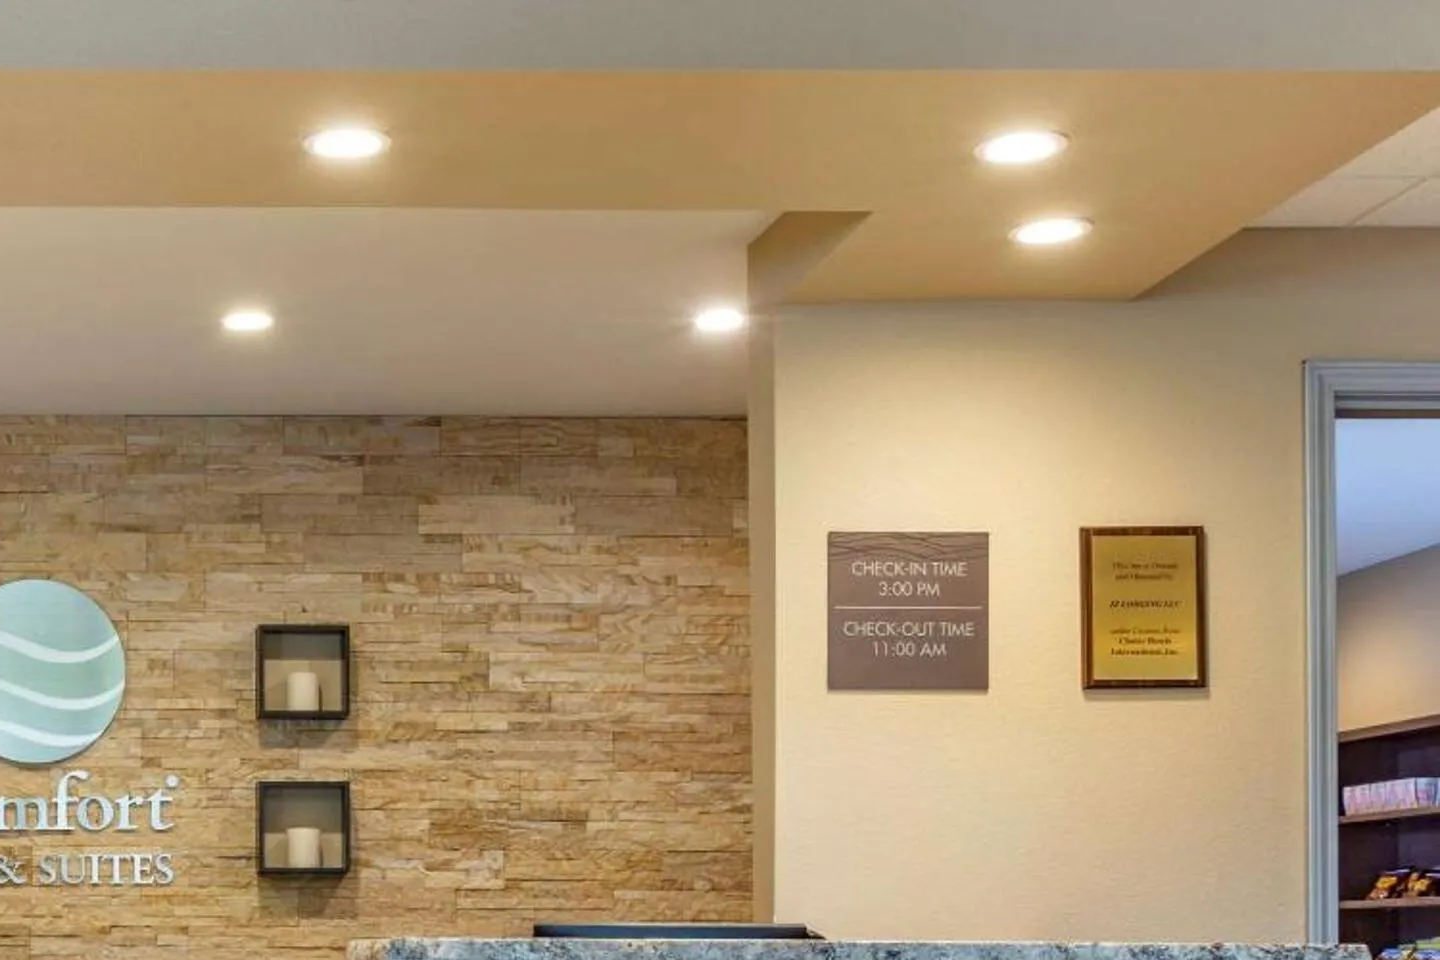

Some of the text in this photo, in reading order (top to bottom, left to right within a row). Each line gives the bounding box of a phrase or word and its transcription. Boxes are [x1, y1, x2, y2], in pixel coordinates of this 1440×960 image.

[851, 561, 969, 577] CHECK-IN TIME
[878, 580, 941, 597] 3:00 PM
[843, 620, 975, 637] CHECK-OUT TIME
[873, 641, 948, 657] 11:00 AM
[38, 852, 175, 886] SUITES
